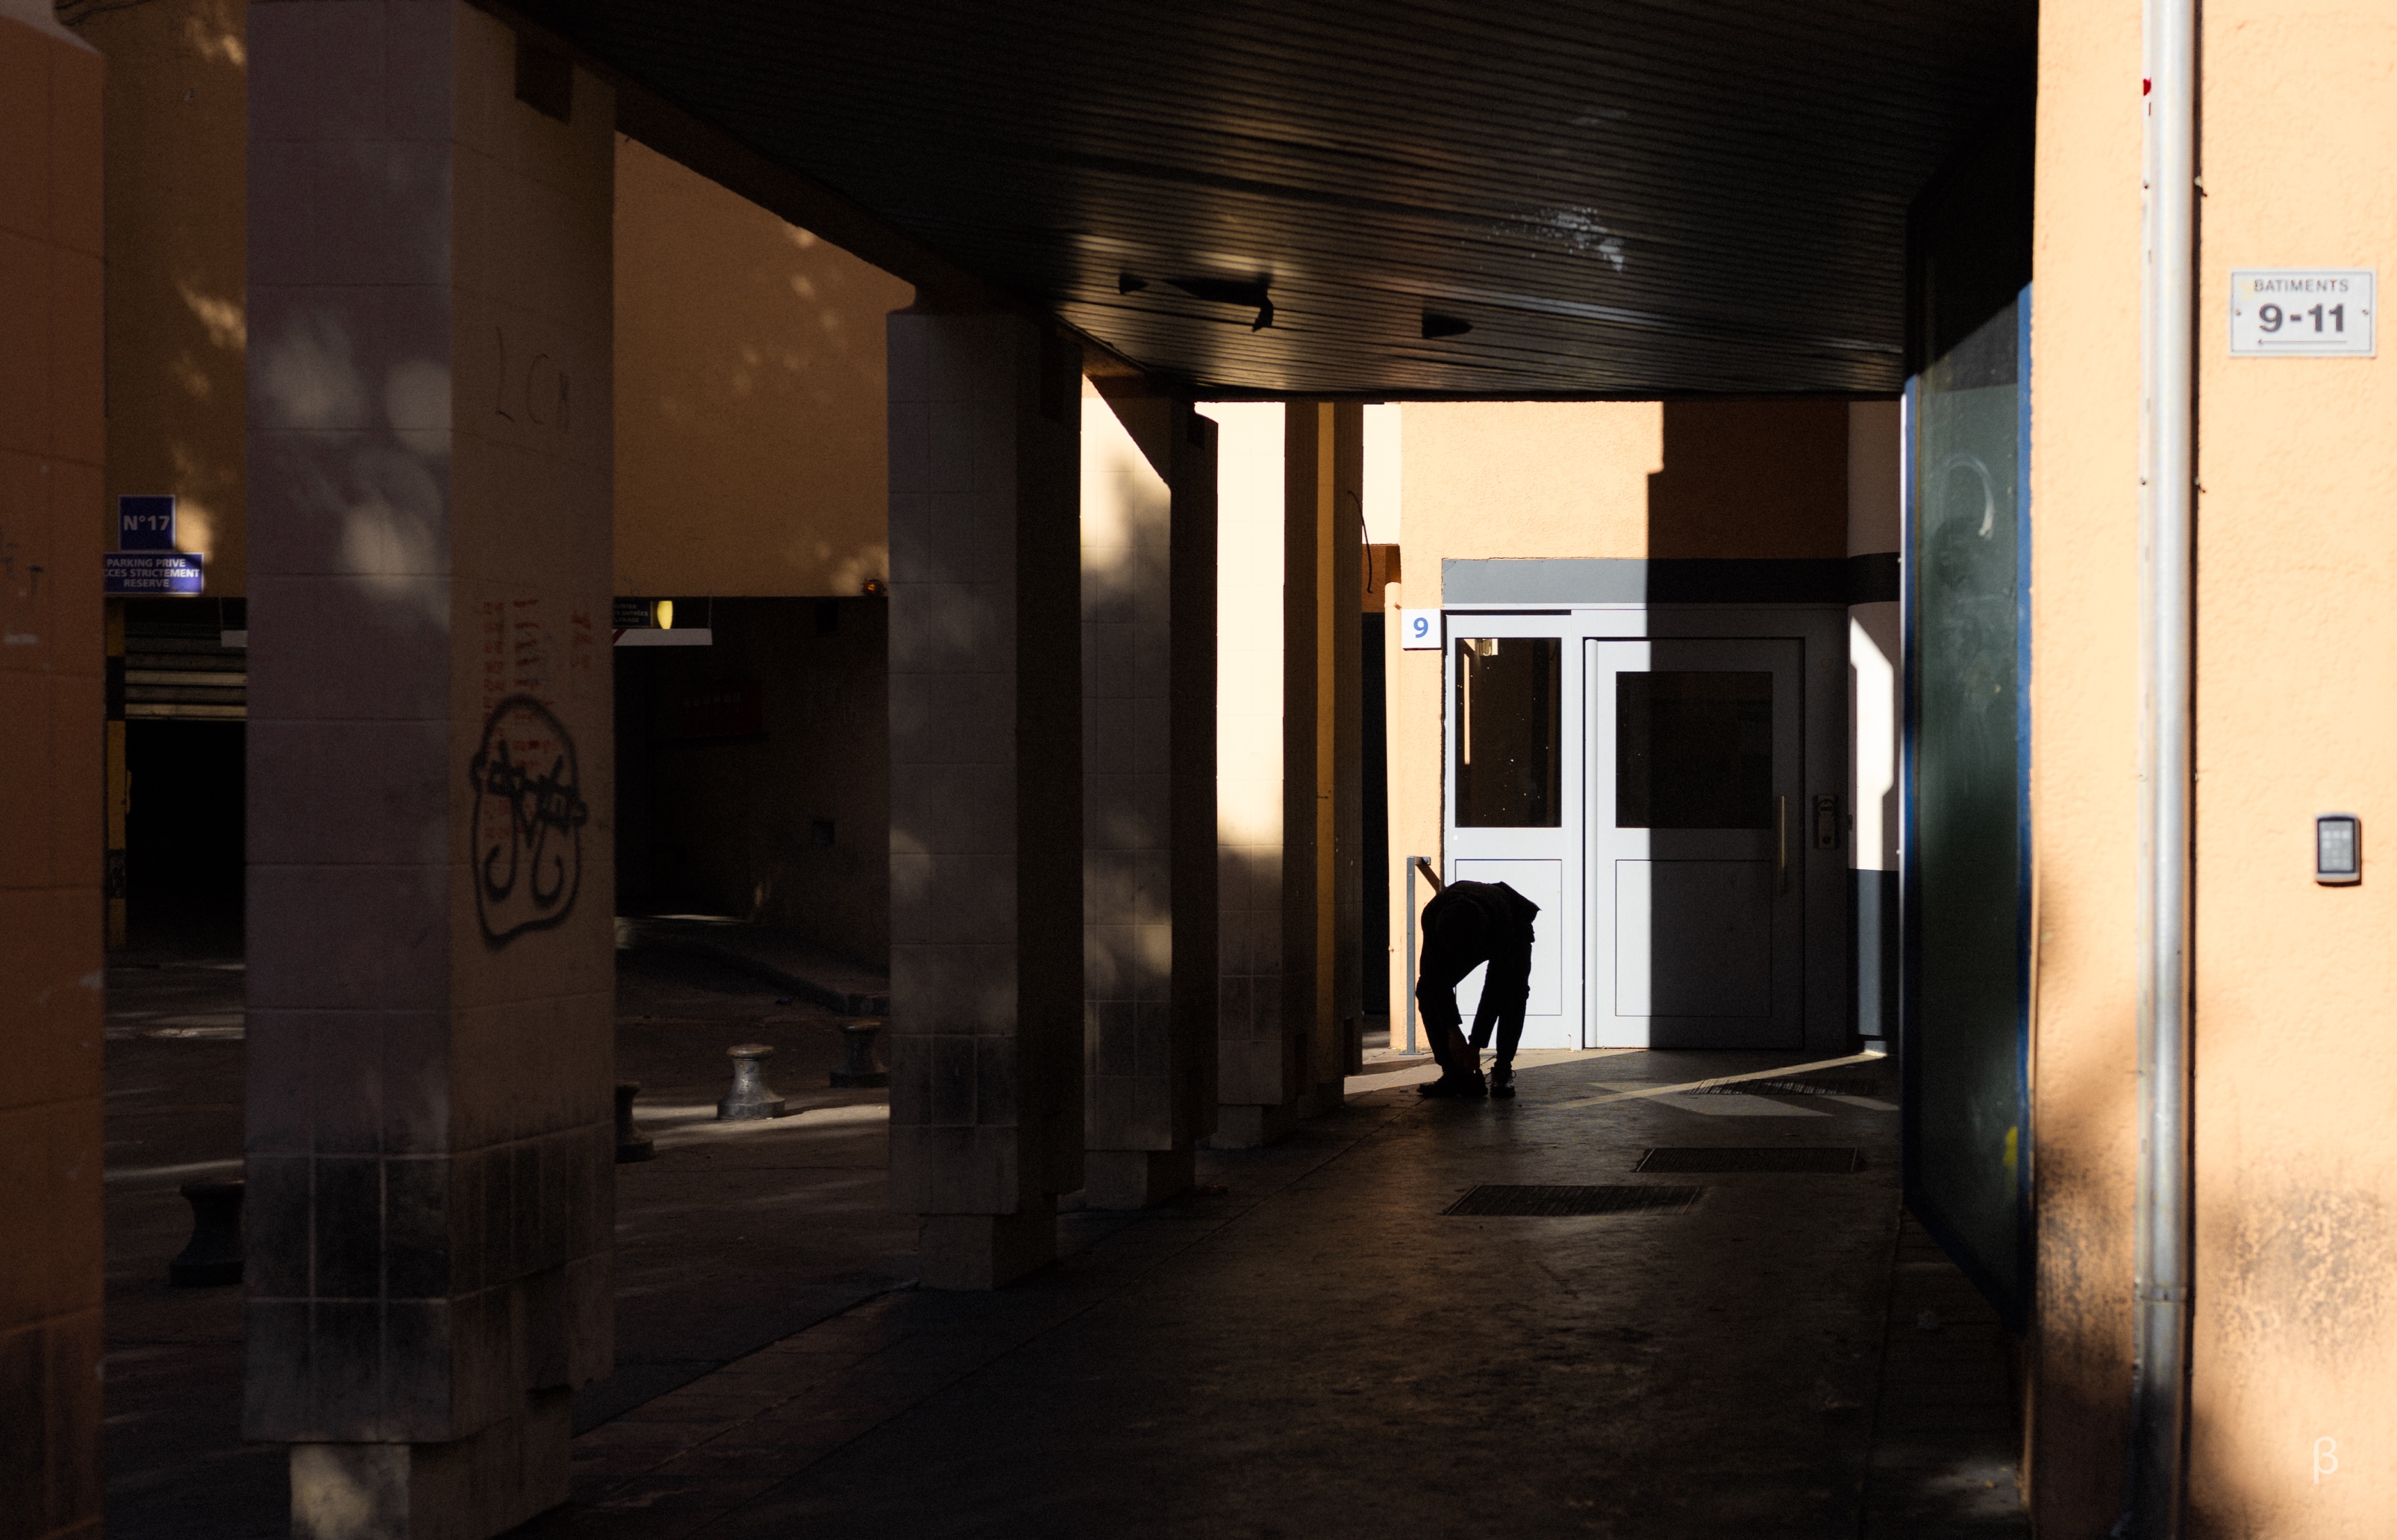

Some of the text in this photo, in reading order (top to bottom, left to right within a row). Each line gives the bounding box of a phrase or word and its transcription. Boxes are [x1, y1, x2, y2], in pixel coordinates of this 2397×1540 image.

[2254, 279, 2349, 292] BATIMENTS
[2259, 303, 2344, 333] 9-11
[123, 516, 170, 530] N°17
[107, 559, 186, 567] PARKING PRIVE
[130, 569, 200, 578] STRICTEMENT
[123, 579, 169, 587] RESERVE
[1413, 616, 1429, 639] 9
